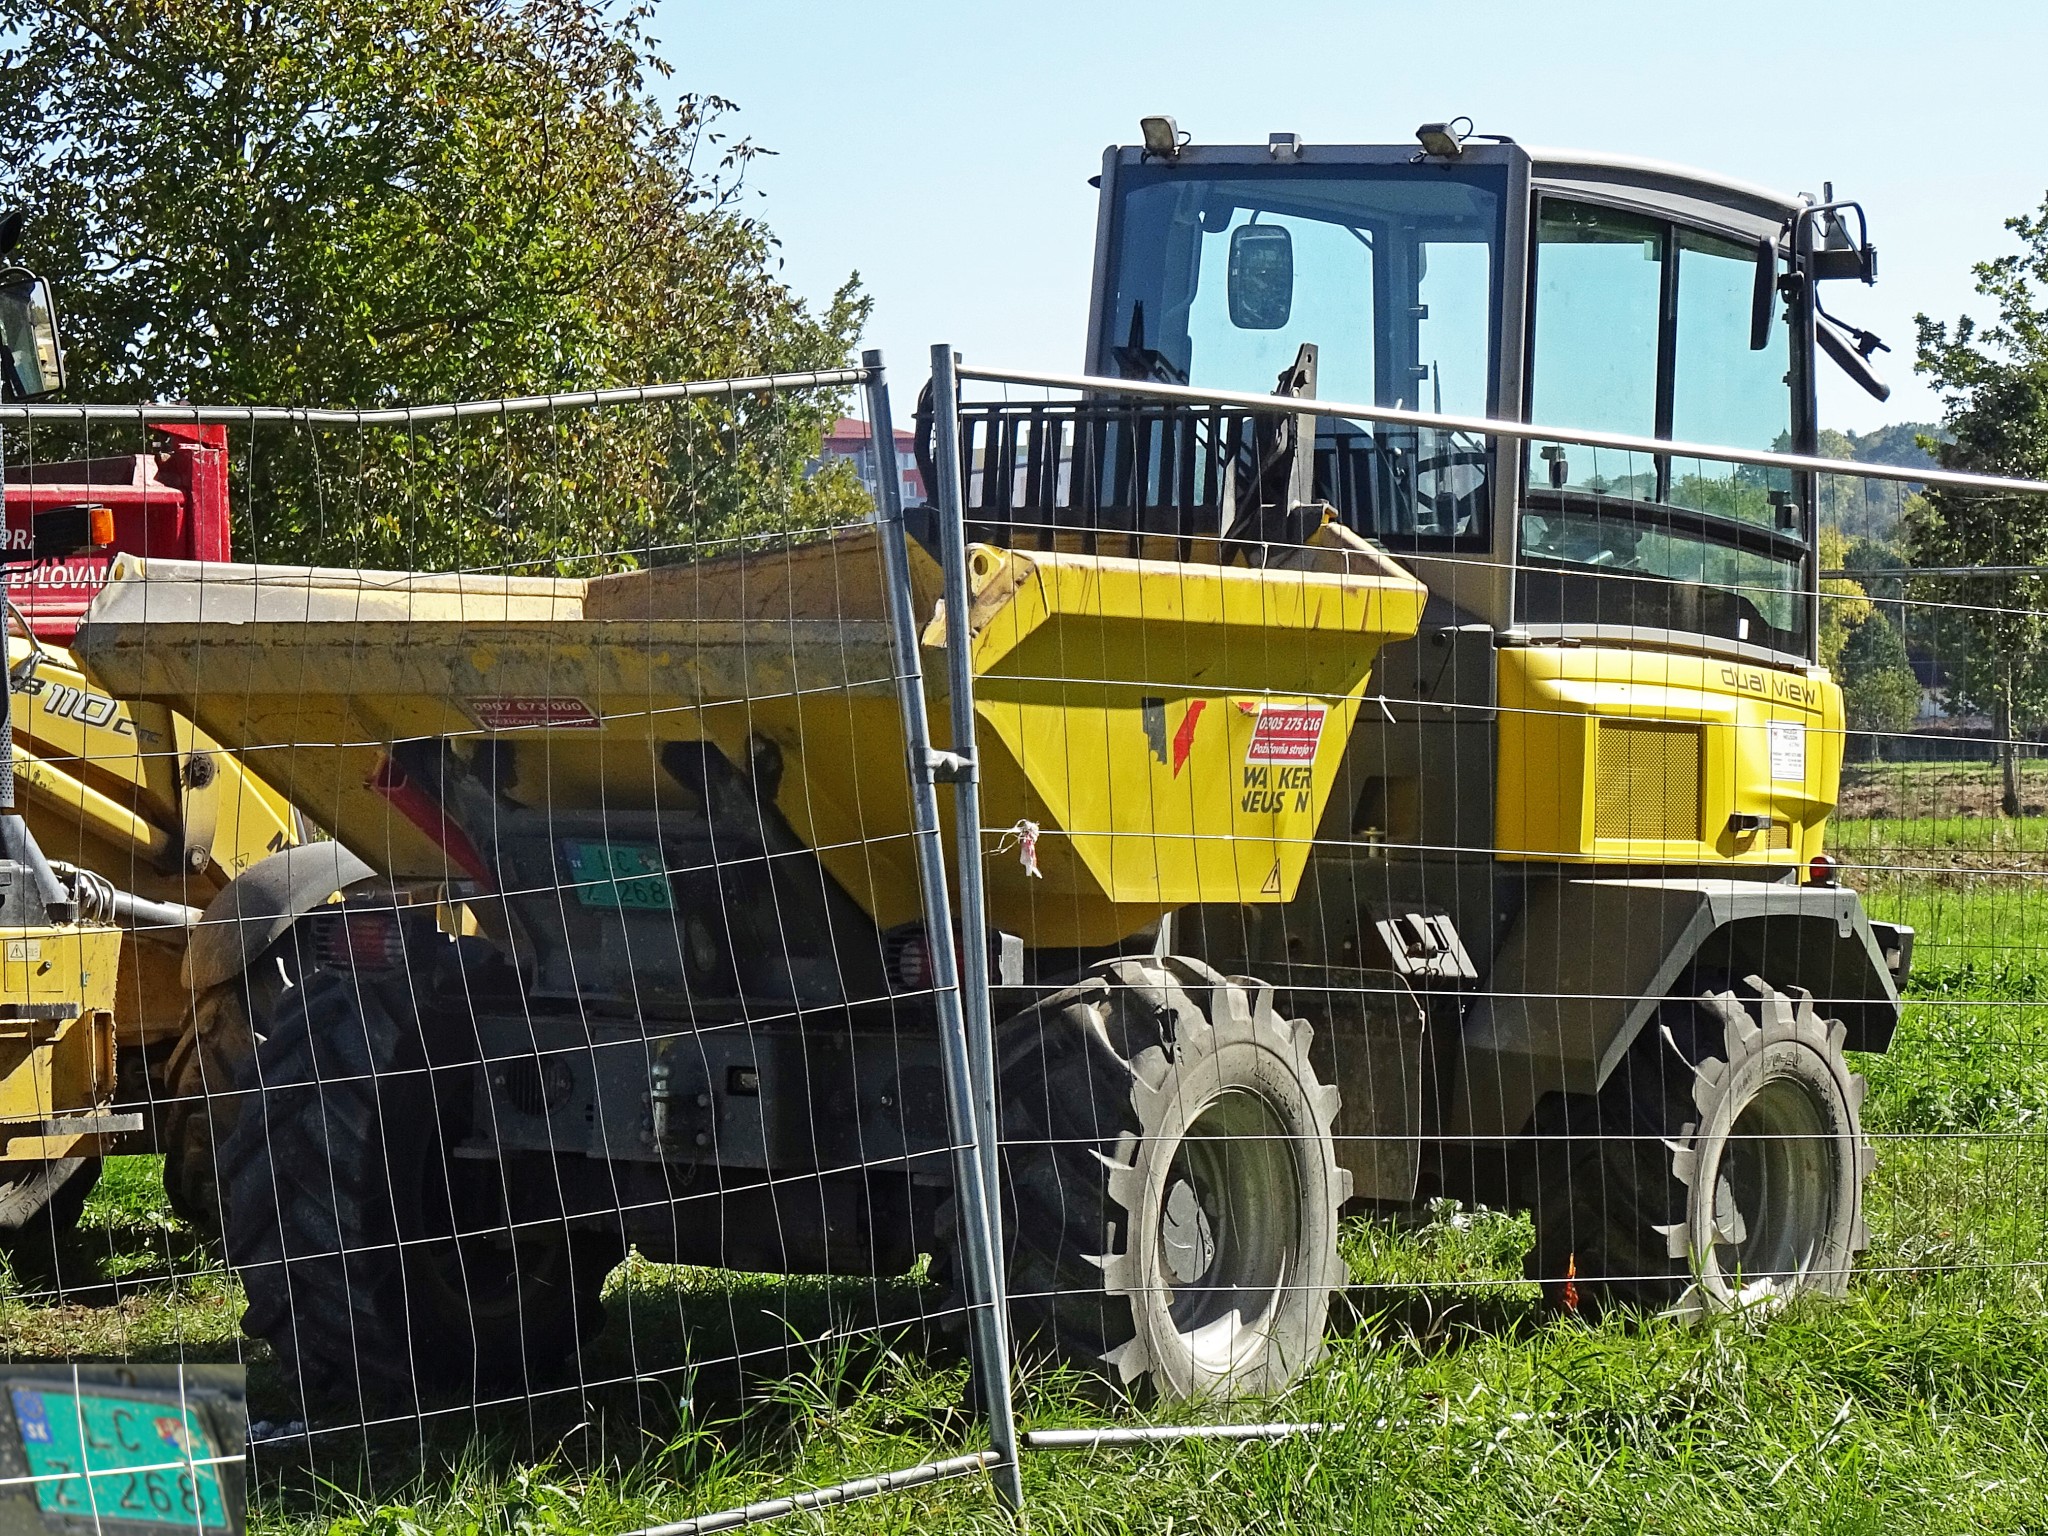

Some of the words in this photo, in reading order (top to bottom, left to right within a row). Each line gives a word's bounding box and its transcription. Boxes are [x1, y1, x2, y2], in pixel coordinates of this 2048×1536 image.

[1721, 667, 1766, 693] dual
[1772, 678, 1815, 705] view
[1284, 717, 1303, 730] 275
[616, 880, 667, 904] 268
[79, 1404, 141, 1452] LC
[113, 1466, 206, 1516] 268
